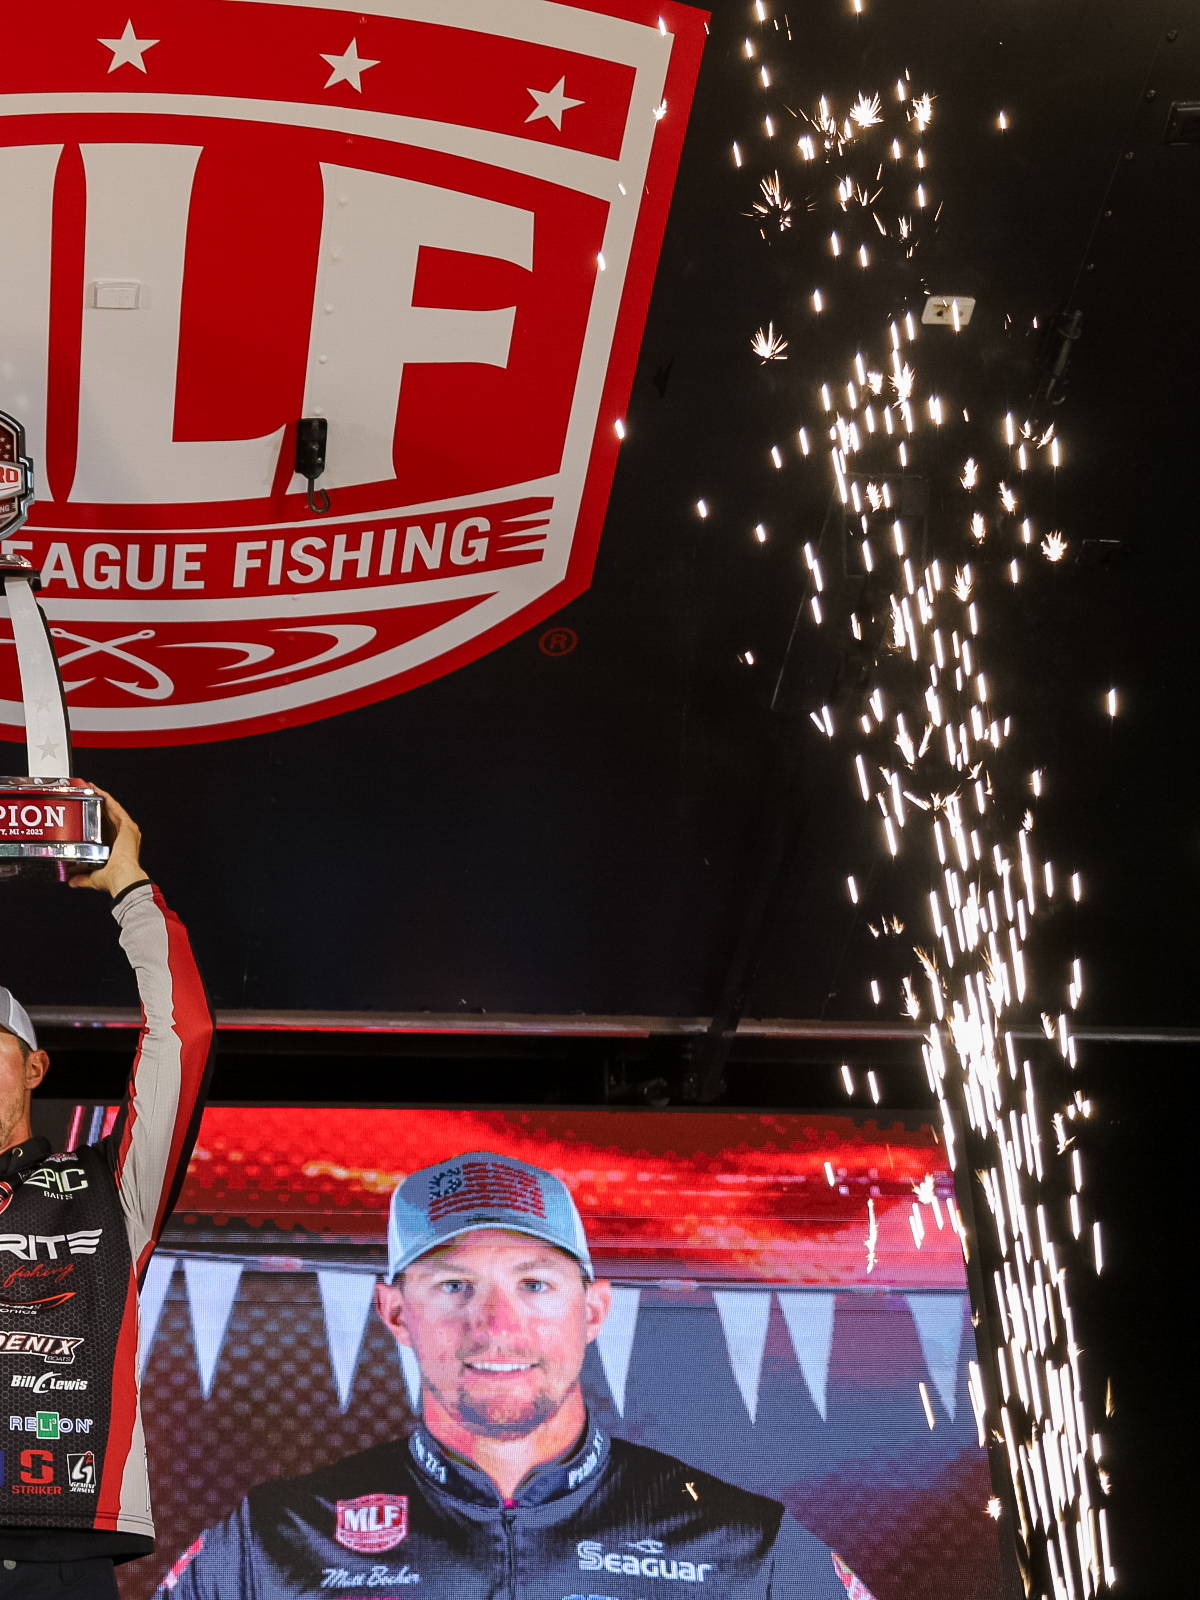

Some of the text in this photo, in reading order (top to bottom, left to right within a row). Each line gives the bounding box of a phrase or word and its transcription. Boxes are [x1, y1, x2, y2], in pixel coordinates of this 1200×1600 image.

[0, 539, 208, 592] AGUE
[232, 515, 492, 588] FISHING
[9, 828, 20, 836] MI
[11, 1375, 89, 1391] Bill Lewis
[11, 1484, 62, 1495] STRIKER
[344, 1505, 403, 1532] MLF
